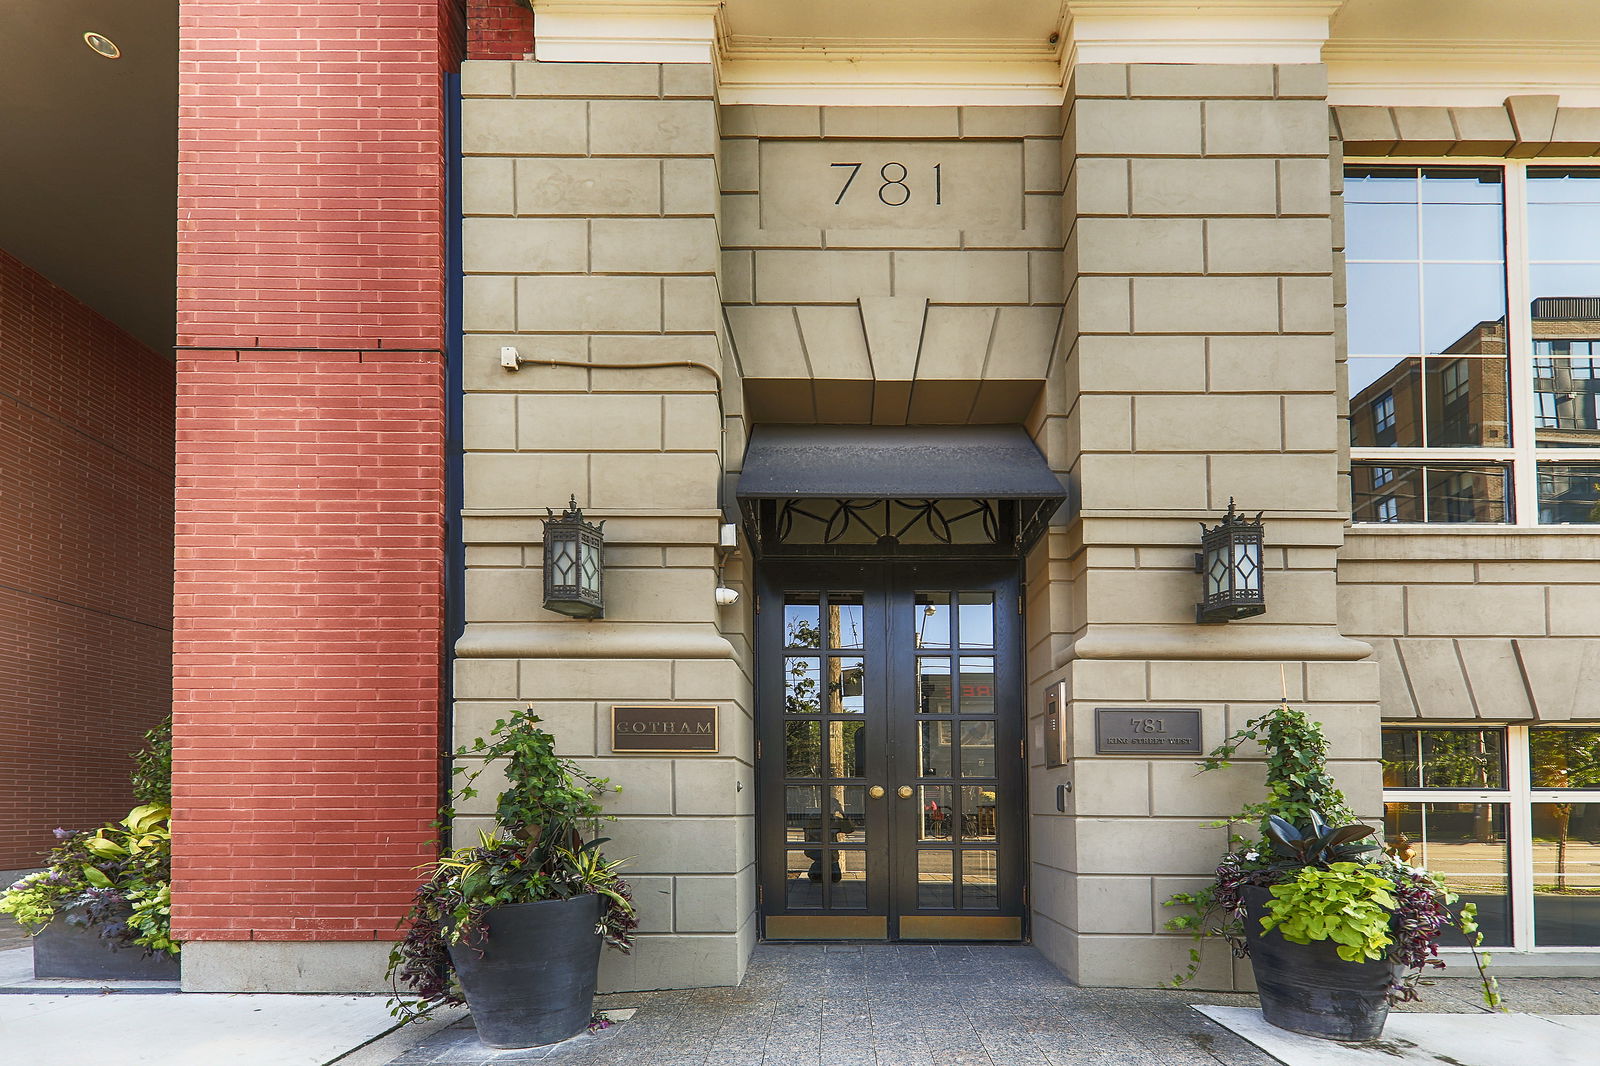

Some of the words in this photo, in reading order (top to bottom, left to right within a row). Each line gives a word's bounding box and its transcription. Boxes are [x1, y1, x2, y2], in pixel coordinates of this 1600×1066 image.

[830, 162, 941, 206] 781
[616, 721, 713, 734] GOTHAM
[1130, 718, 1168, 734] 781
[1106, 736, 1128, 745] KING
[1131, 736, 1165, 745] STREET
[1168, 736, 1193, 745] WEST
